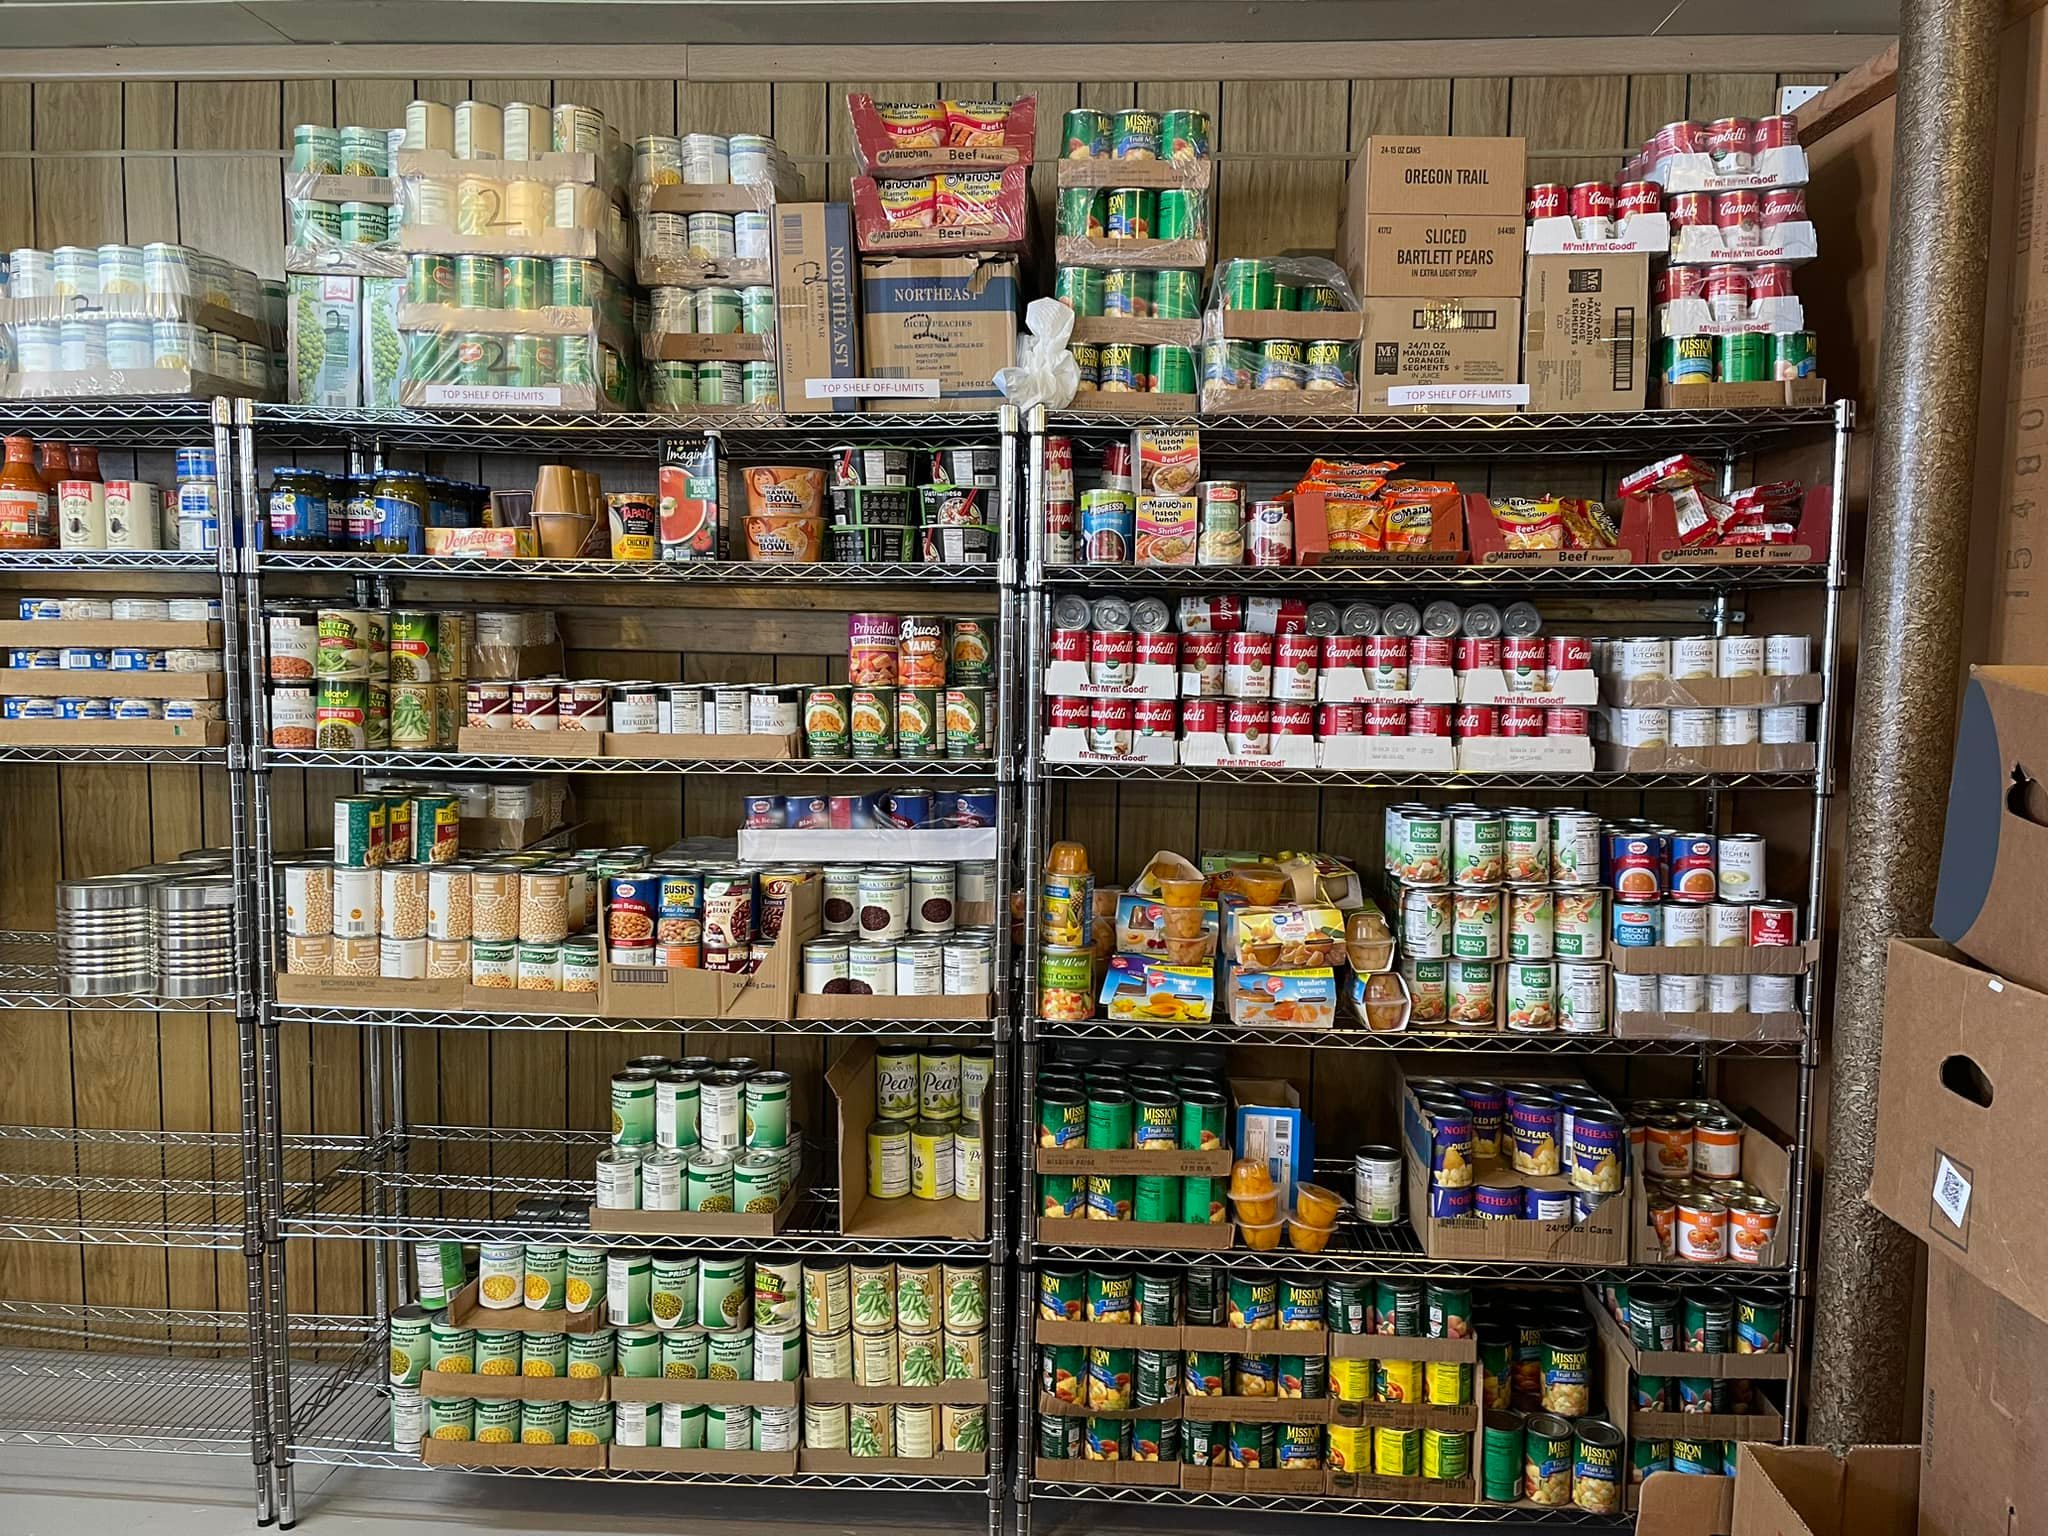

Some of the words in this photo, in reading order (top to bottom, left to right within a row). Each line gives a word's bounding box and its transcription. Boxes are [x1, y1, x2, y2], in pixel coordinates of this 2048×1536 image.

[897, 126, 916, 135] Beef
[888, 150, 929, 159] Maruchan
[949, 149, 977, 160] Beef
[1397, 146, 1405, 154] OZ
[1406, 146, 1422, 154] CANS
[1404, 168, 1452, 185] OREGON
[1456, 169, 1489, 184] TRAIL
[1749, 174, 1777, 185] Good!
[877, 179, 928, 190] Maruchan
[477, 187, 523, 227] 2
[879, 229, 919, 239] Maruchan
[938, 228, 967, 239] Beef
[1425, 228, 1467, 245] SLICED
[1563, 242, 1585, 251] M'm!
[1585, 242, 1608, 251] M'm!
[1608, 242, 1635, 251] Good!
[1397, 249, 1452, 265] BARTLETT
[1456, 249, 1494, 265] PEARS
[1756, 247, 1783, 257] Good!
[1411, 269, 1418, 277] IN
[1419, 269, 1438, 277] EXTRA
[1439, 269, 1456, 277] LIGHT
[1457, 269, 1478, 278] SYRUP
[893, 287, 978, 302] NORTHEAST
[830, 245, 849, 367] NORTHEAST
[932, 320, 973, 328] PEACHES
[1578, 302, 1586, 340] ORANGE
[1586, 297, 1594, 346] MANDARIN
[903, 312, 950, 343] 2
[1407, 342, 1431, 350] 24/11
[1433, 342, 1446, 350] OZ
[481, 340, 521, 373] 2
[823, 384, 842, 393] TOP
[843, 383, 872, 393] SHELF
[873, 383, 925, 393] OFF-LIMITS
[442, 389, 460, 399] TOP
[462, 390, 490, 399] SHELF
[492, 391, 545, 401] OFF-LIMITS
[1406, 391, 1426, 400] TOP
[1427, 390, 1458, 399] SHELF
[1459, 388, 1513, 399] OFF-LIMITS
[766, 494, 800, 503] BOWL
[1150, 500, 1193, 510] Maruchan
[1155, 515, 1179, 523] Lunch
[1527, 510, 1547, 518] Soup
[1158, 526, 1184, 535] Shrimp
[626, 538, 651, 548] CHICKEN
[760, 543, 793, 551] BOWL
[1334, 553, 1390, 561] Maruchan
[1396, 553, 1456, 562] Chicken
[1496, 551, 1540, 561] Maruchan
[1558, 551, 1588, 562] Beef
[1735, 547, 1766, 559] Beef
[1768, 549, 1792, 558] Flavor
[853, 622, 894, 635] Princella
[900, 619, 941, 640] Bruce's
[870, 636, 896, 646] Potatoes
[908, 640, 936, 651] YAMS
[1079, 683, 1100, 692] M'm!
[1101, 684, 1121, 693] M'm!
[1121, 684, 1147, 694] Good!
[328, 697, 344, 705] sun
[1538, 696, 1564, 705] Good!
[1120, 753, 1147, 762] Good!
[1216, 758, 1238, 766] M'm!
[1259, 759, 1285, 767] Good!
[1412, 830, 1439, 839] Choice
[1507, 830, 1533, 838] Choice
[663, 883, 695, 896] BUSH'S
[624, 902, 646, 912] Beans
[1619, 926, 1650, 934] CHICKEN
[1620, 933, 1650, 941] NOODLE
[1063, 957, 1087, 968] West
[1418, 970, 1442, 978] Choice
[1464, 970, 1489, 978] Choice
[1297, 979, 1327, 987] Mandarin
[1299, 986, 1326, 994] Oranges
[1143, 1107, 1178, 1121] MISSION
[1150, 1118, 1172, 1126] PRIDE
[1526, 1129, 1551, 1139] PEARS
[1587, 1144, 1613, 1155] PEARS
[1545, 1224, 1570, 1232] 24/15
[1589, 1225, 1613, 1234] Cans
[668, 1267, 692, 1277] PRIDE
[657, 1279, 672, 1287] Sweet
[1290, 1287, 1323, 1302] MISSION
[397, 1325, 421, 1335] PRIDE
[723, 1339, 747, 1349] PRIDE
[1551, 1351, 1587, 1368] MISSION
[1558, 1363, 1582, 1371] PRIDE
[1287, 1426, 1320, 1442] MISSION
[1580, 1442, 1618, 1462] MISSION
[1587, 1457, 1613, 1466] PRIDE
